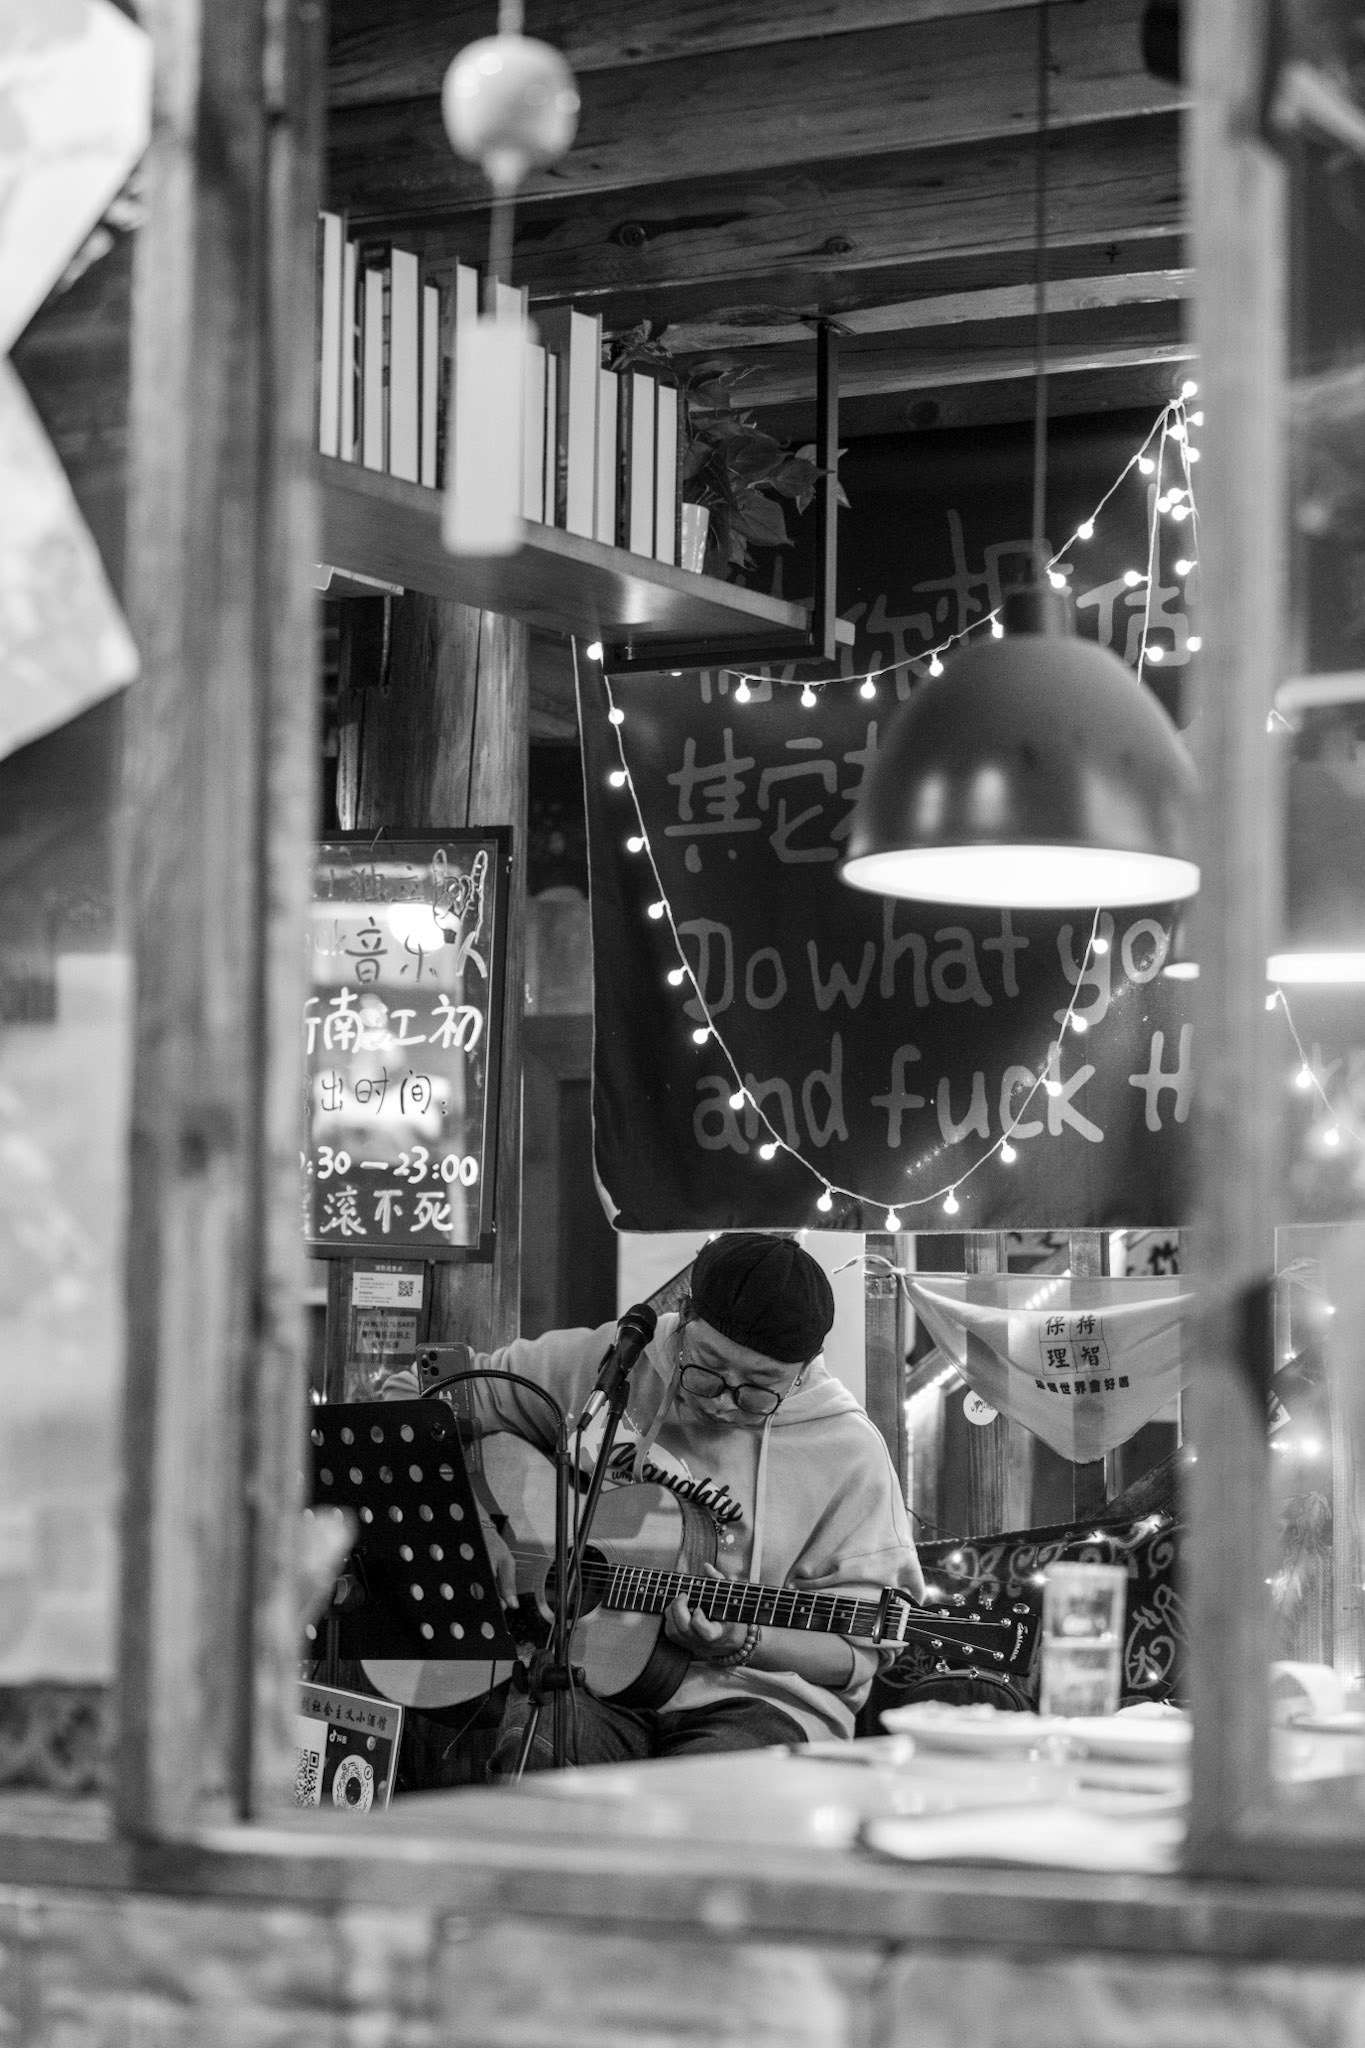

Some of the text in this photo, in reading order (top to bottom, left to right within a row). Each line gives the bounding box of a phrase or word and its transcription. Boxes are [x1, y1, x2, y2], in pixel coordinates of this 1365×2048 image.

[676, 917, 788, 1022] Do
[806, 899, 1030, 1010] what
[306, 1066, 448, 1116] 出时间:
[693, 1033, 850, 1153] and
[871, 1041, 1105, 1147] fuck
[303, 1185, 454, 1236] 滚不死
[1046, 1346, 1100, 1368] 理智
